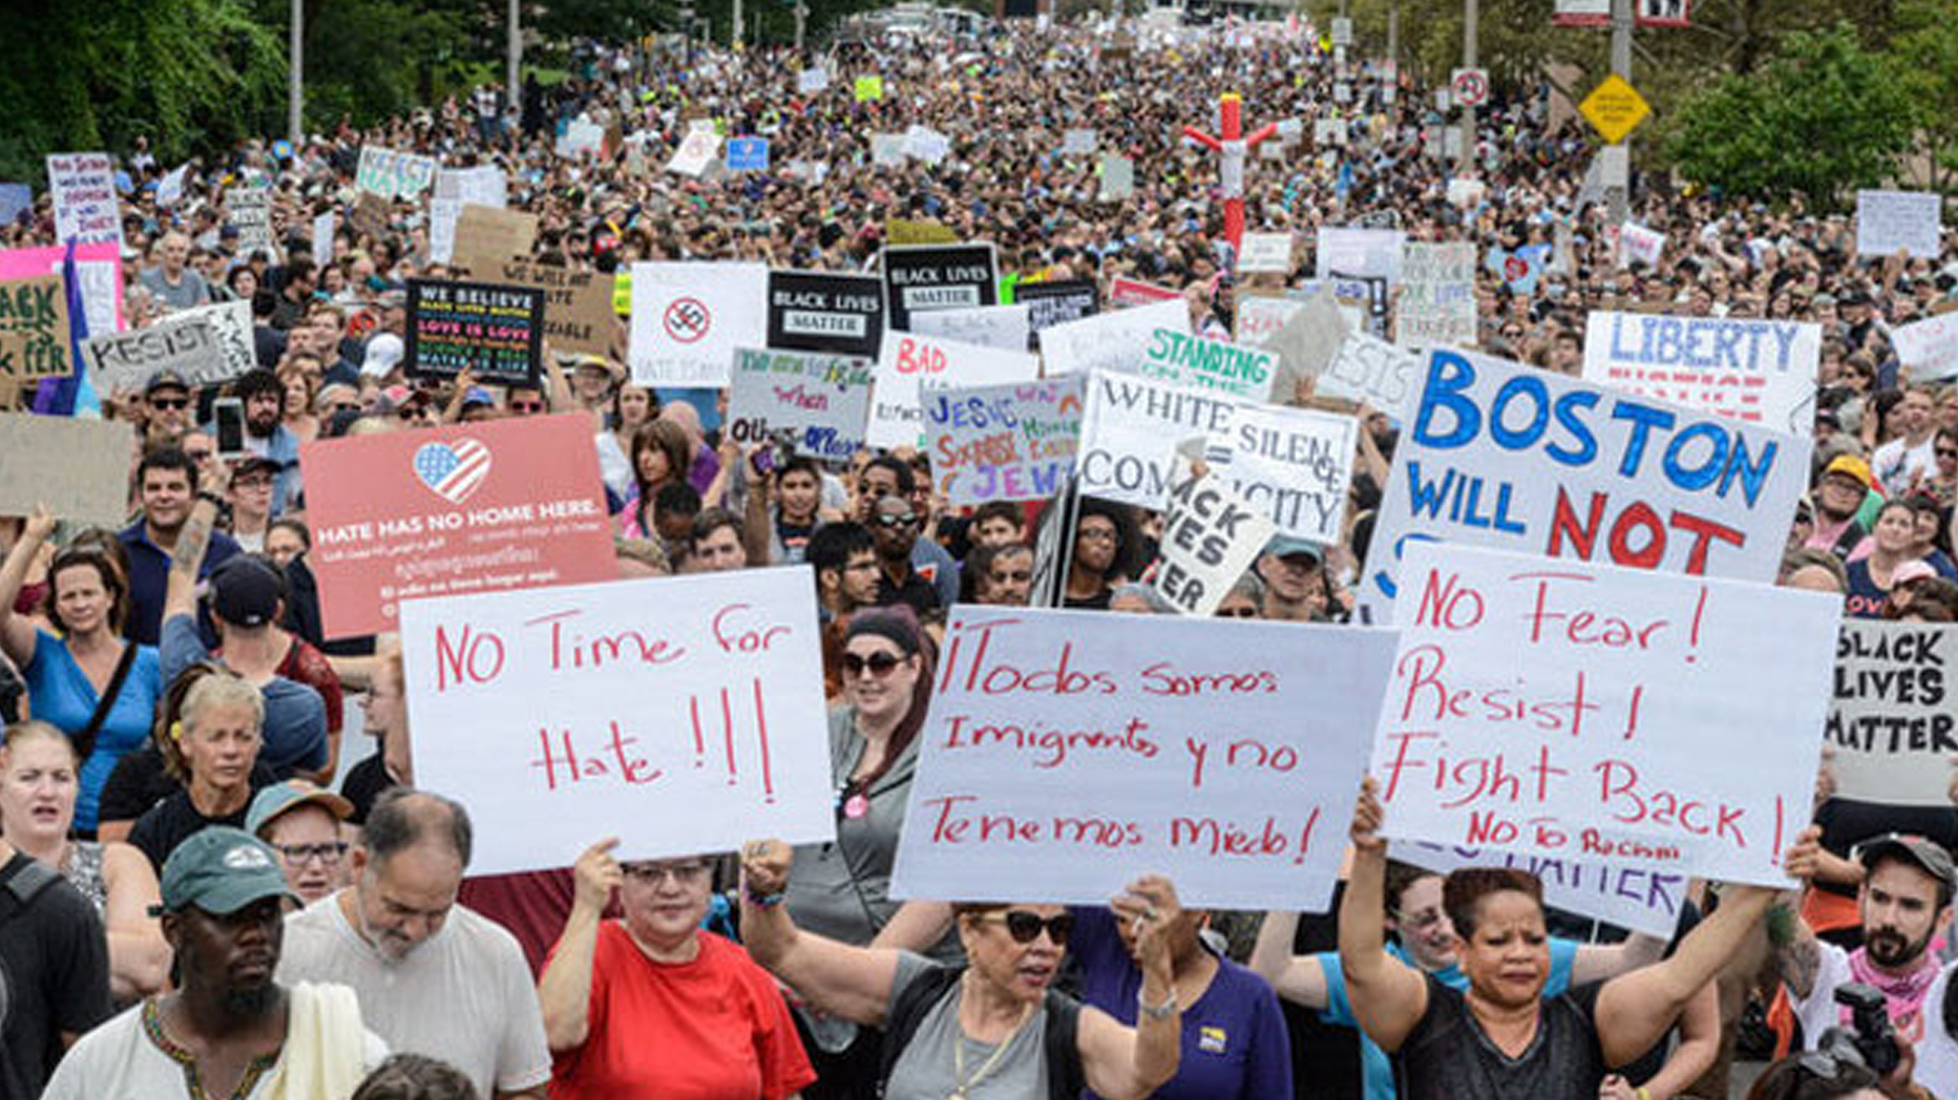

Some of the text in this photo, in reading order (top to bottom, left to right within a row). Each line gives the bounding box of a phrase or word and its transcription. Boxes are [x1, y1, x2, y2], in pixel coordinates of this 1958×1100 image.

[420, 286, 533, 308] WE BELIEVE
[891, 265, 989, 285] BLACK LIVES
[910, 289, 972, 304] MATTER
[0, 285, 59, 319] ACK
[773, 291, 880, 312] BLACK LIVES
[792, 315, 858, 331] MATTER
[418, 319, 461, 334] LOVE
[466, 323, 483, 336] IS
[488, 326, 531, 341] LOVE
[1147, 327, 1272, 384] STANDING
[1610, 313, 1800, 371] LIBERTY
[896, 337, 948, 375] BAD
[1330, 337, 1416, 403] ESIS
[929, 394, 1018, 428] JESUS
[1104, 379, 1344, 494] WHITE SILENCE
[1412, 349, 1779, 508] BOSTON
[1081, 449, 1342, 534] COMCITY
[1170, 476, 1252, 541] ACK
[318, 523, 372, 545] HATE
[379, 517, 424, 537] HAS
[428, 512, 464, 530] NO
[468, 503, 534, 526] HOME
[1407, 460, 1526, 535] WILL
[1545, 484, 1747, 577] NOT
[1415, 568, 1486, 633] NO
[435, 623, 505, 693] NO
[523, 609, 686, 671] Time
[1834, 666, 1946, 706] LIVES
[1824, 709, 1958, 754] MATTER
[1186, 737, 1208, 788] y
[1226, 739, 1298, 773] no
[1383, 731, 1569, 810] Fight
[923, 795, 1144, 848] Tenemos
